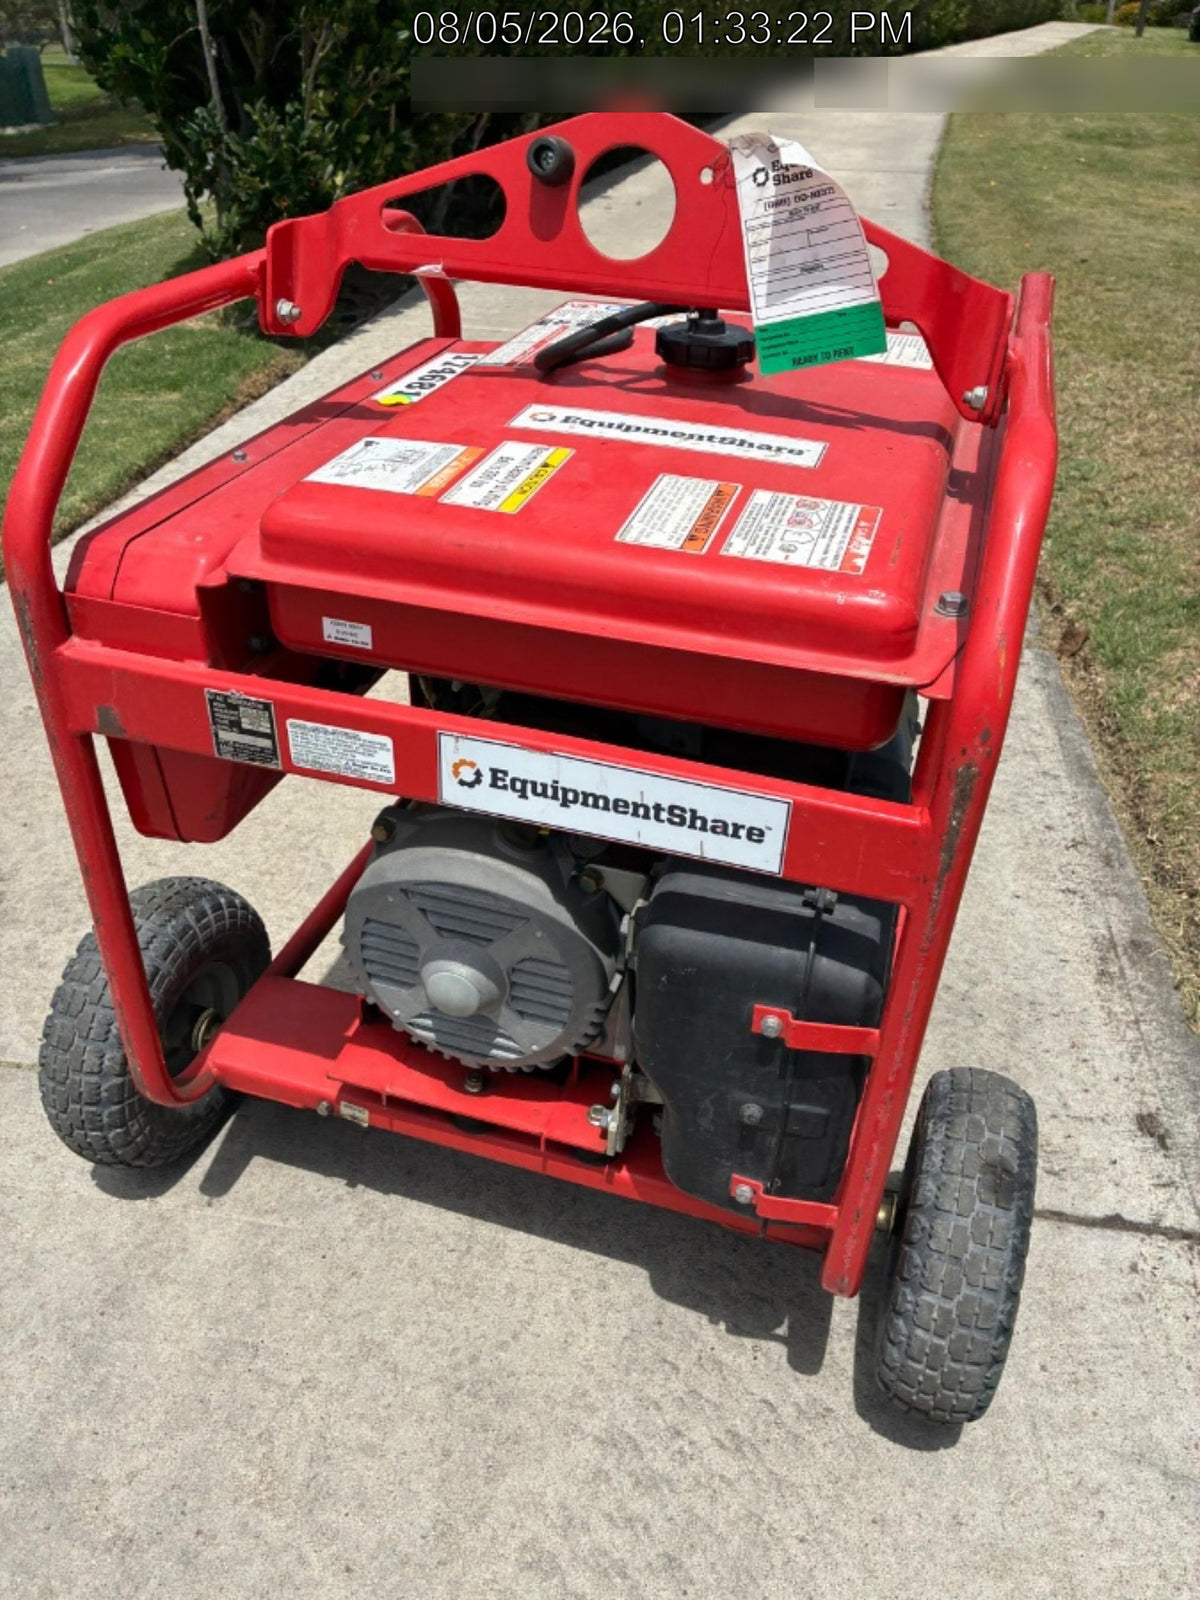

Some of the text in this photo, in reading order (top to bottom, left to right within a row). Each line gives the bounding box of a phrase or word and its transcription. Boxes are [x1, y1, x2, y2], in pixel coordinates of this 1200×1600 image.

[773, 168, 813, 187] Share
[561, 414, 806, 457] EquipmentShare
[488, 767, 767, 844] EquipmentShare
